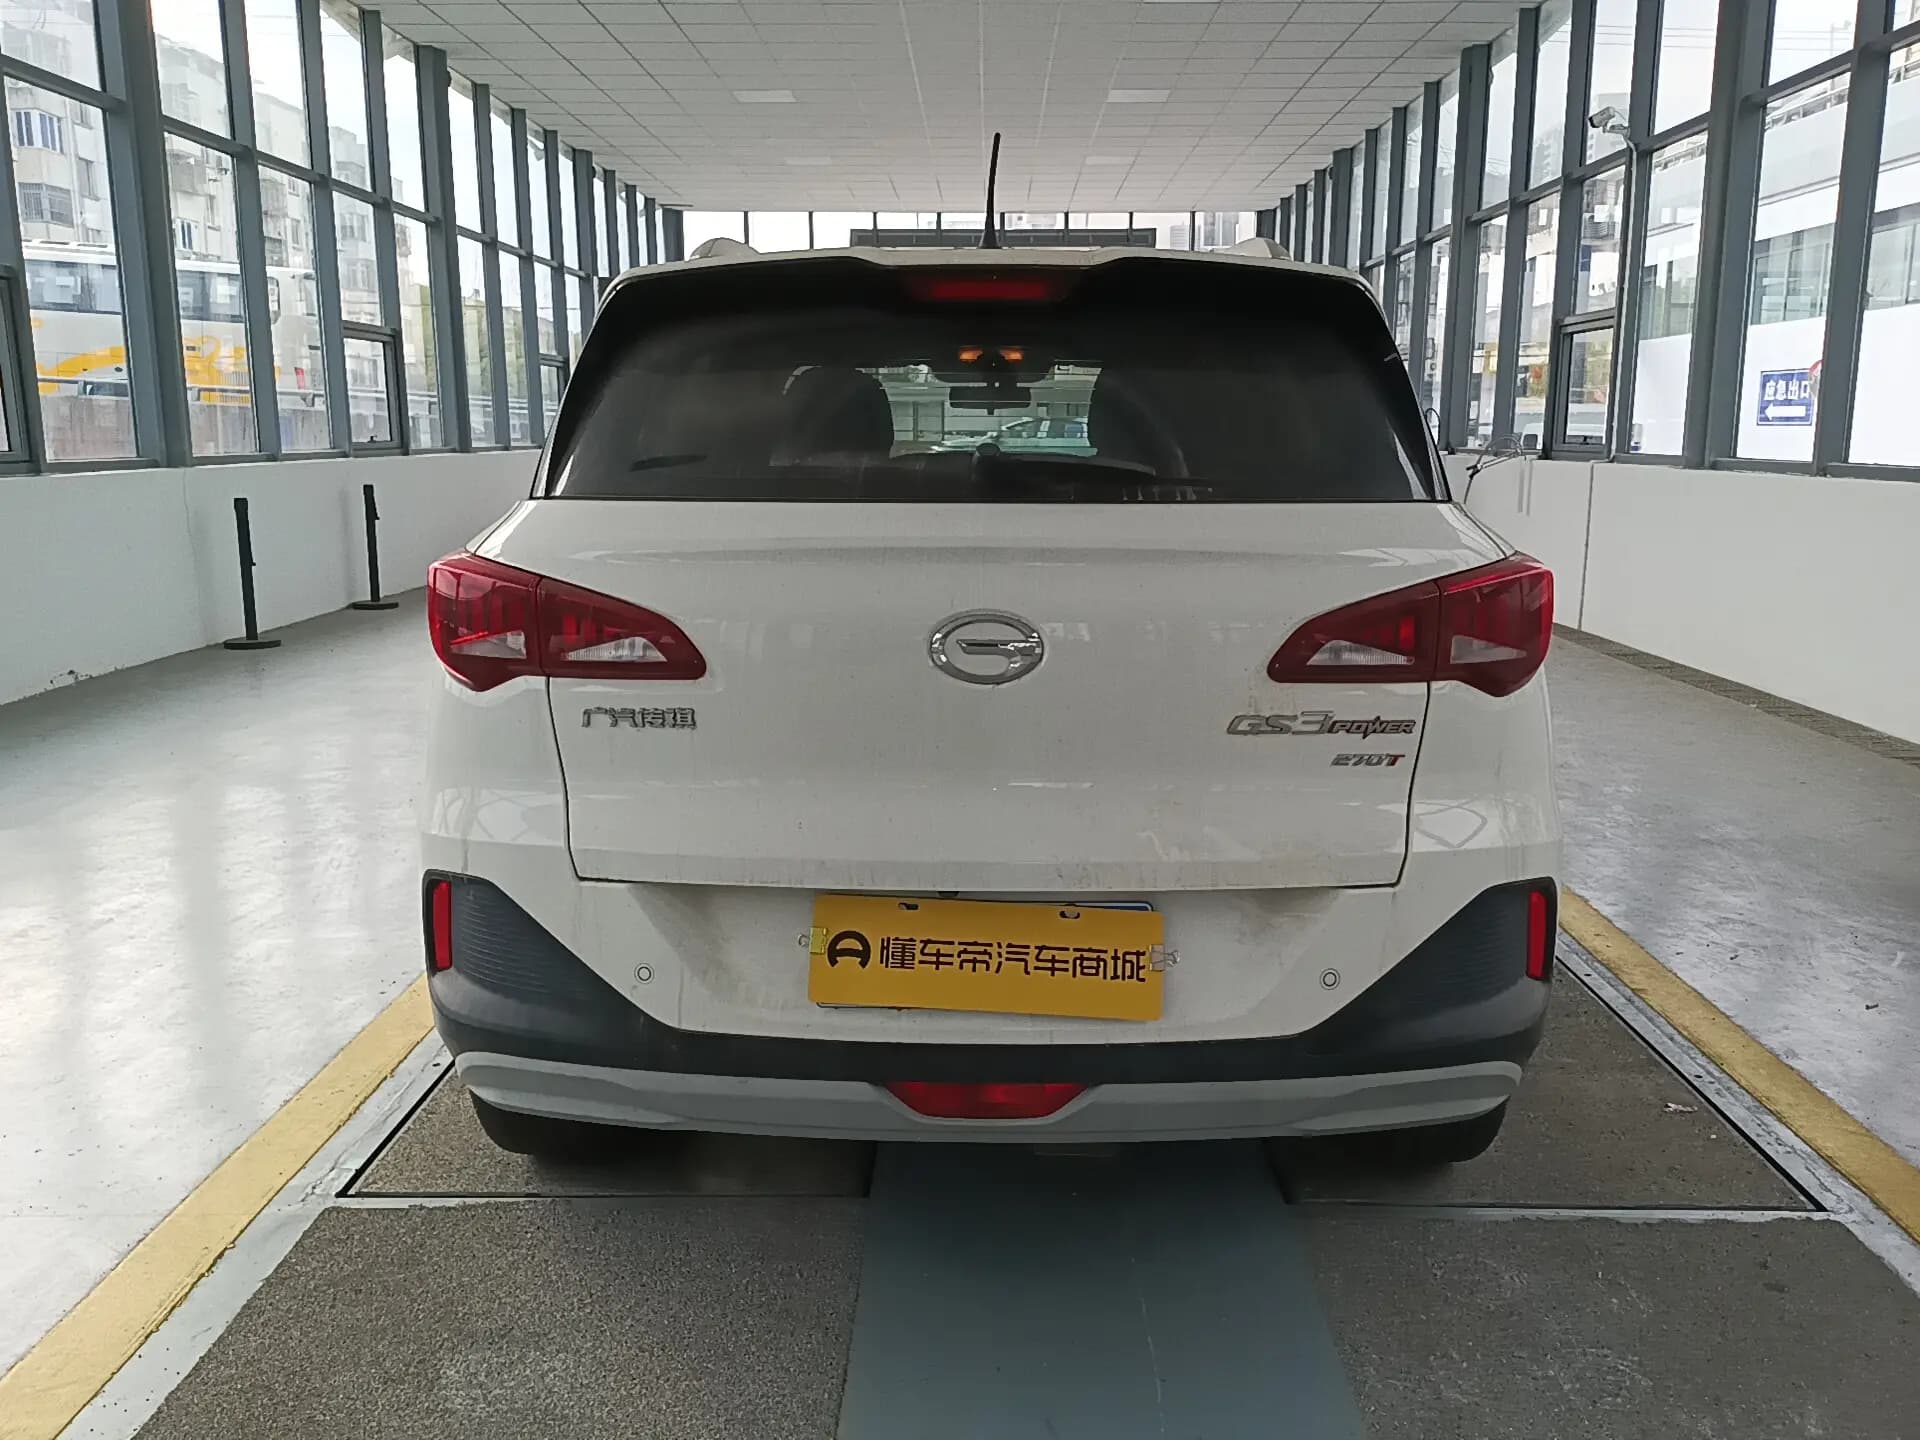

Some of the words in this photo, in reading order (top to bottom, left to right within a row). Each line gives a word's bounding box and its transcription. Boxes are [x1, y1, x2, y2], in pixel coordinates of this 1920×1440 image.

[1764, 379, 1809, 401] 应急出口
[581, 706, 697, 730] 广汽传祺
[1330, 753, 1406, 767] 270T
[879, 936, 1147, 983] 懂车帝汽车商城
